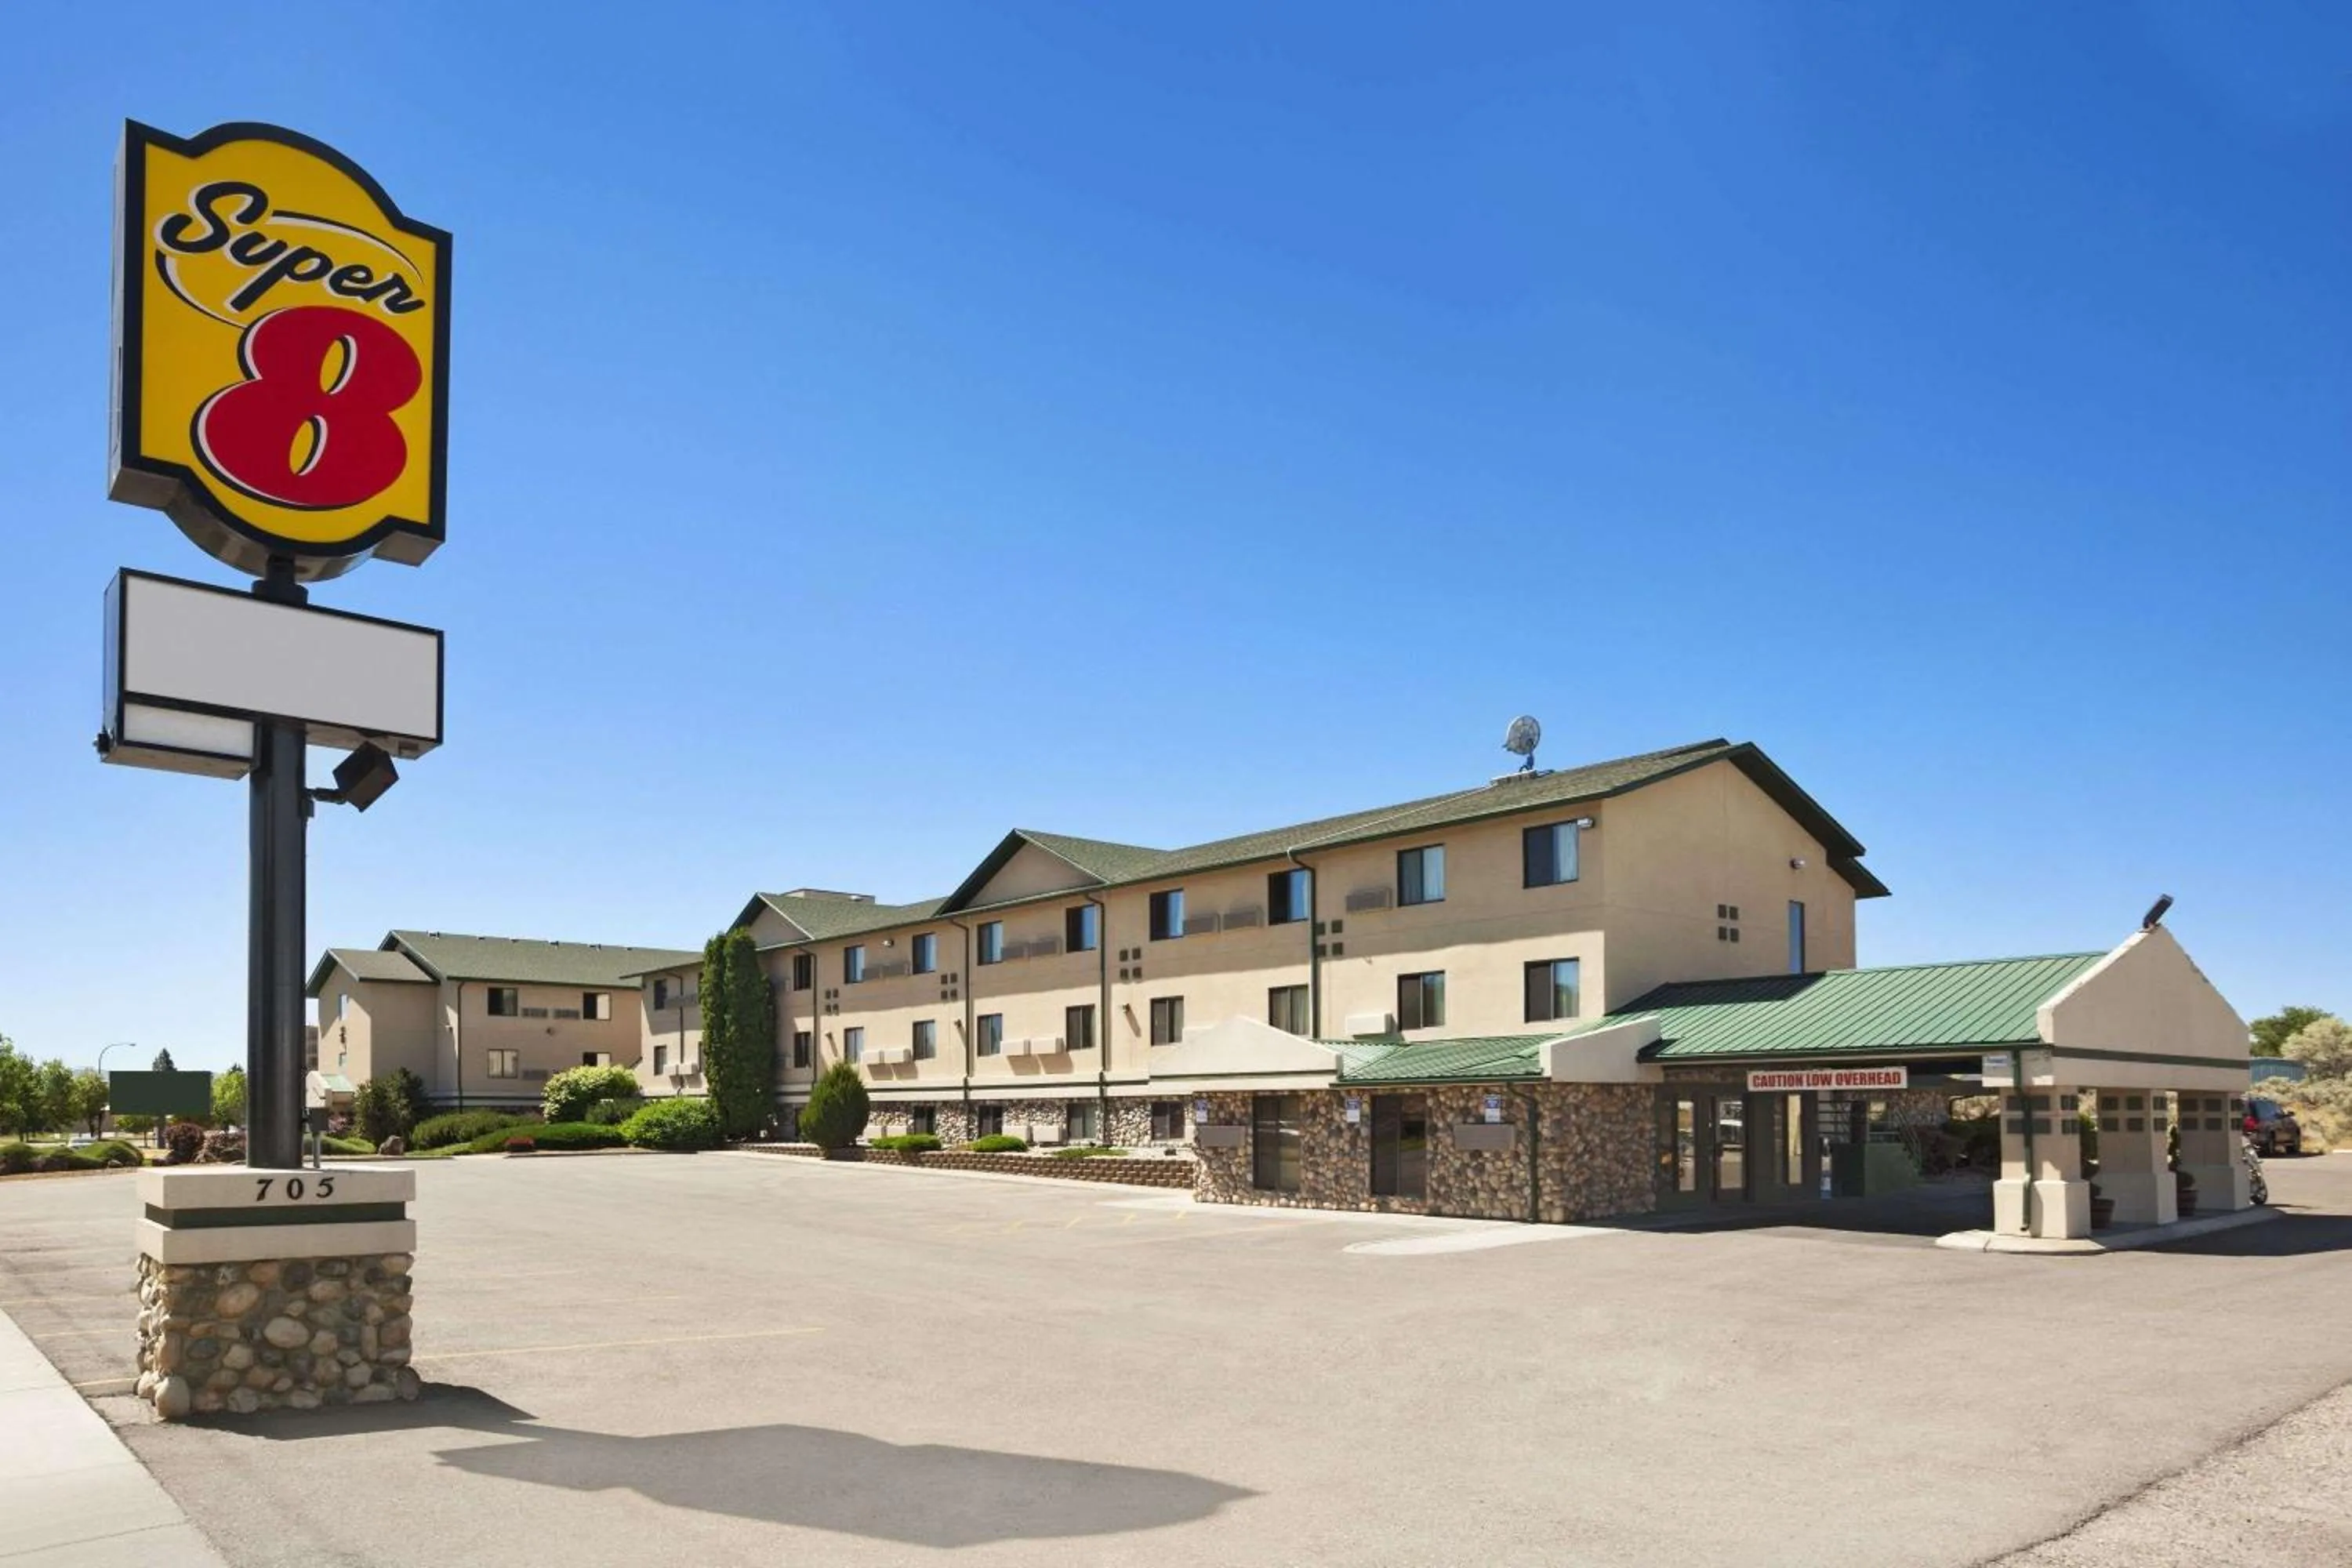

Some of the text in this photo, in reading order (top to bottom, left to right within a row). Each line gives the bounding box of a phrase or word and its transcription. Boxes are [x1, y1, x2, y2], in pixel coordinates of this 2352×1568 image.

[154, 180, 426, 314] Super
[191, 306, 423, 511] 8
[1752, 1072, 1901, 1087] CAUTION LOW OVERHEAD
[256, 1177, 335, 1201] 705
